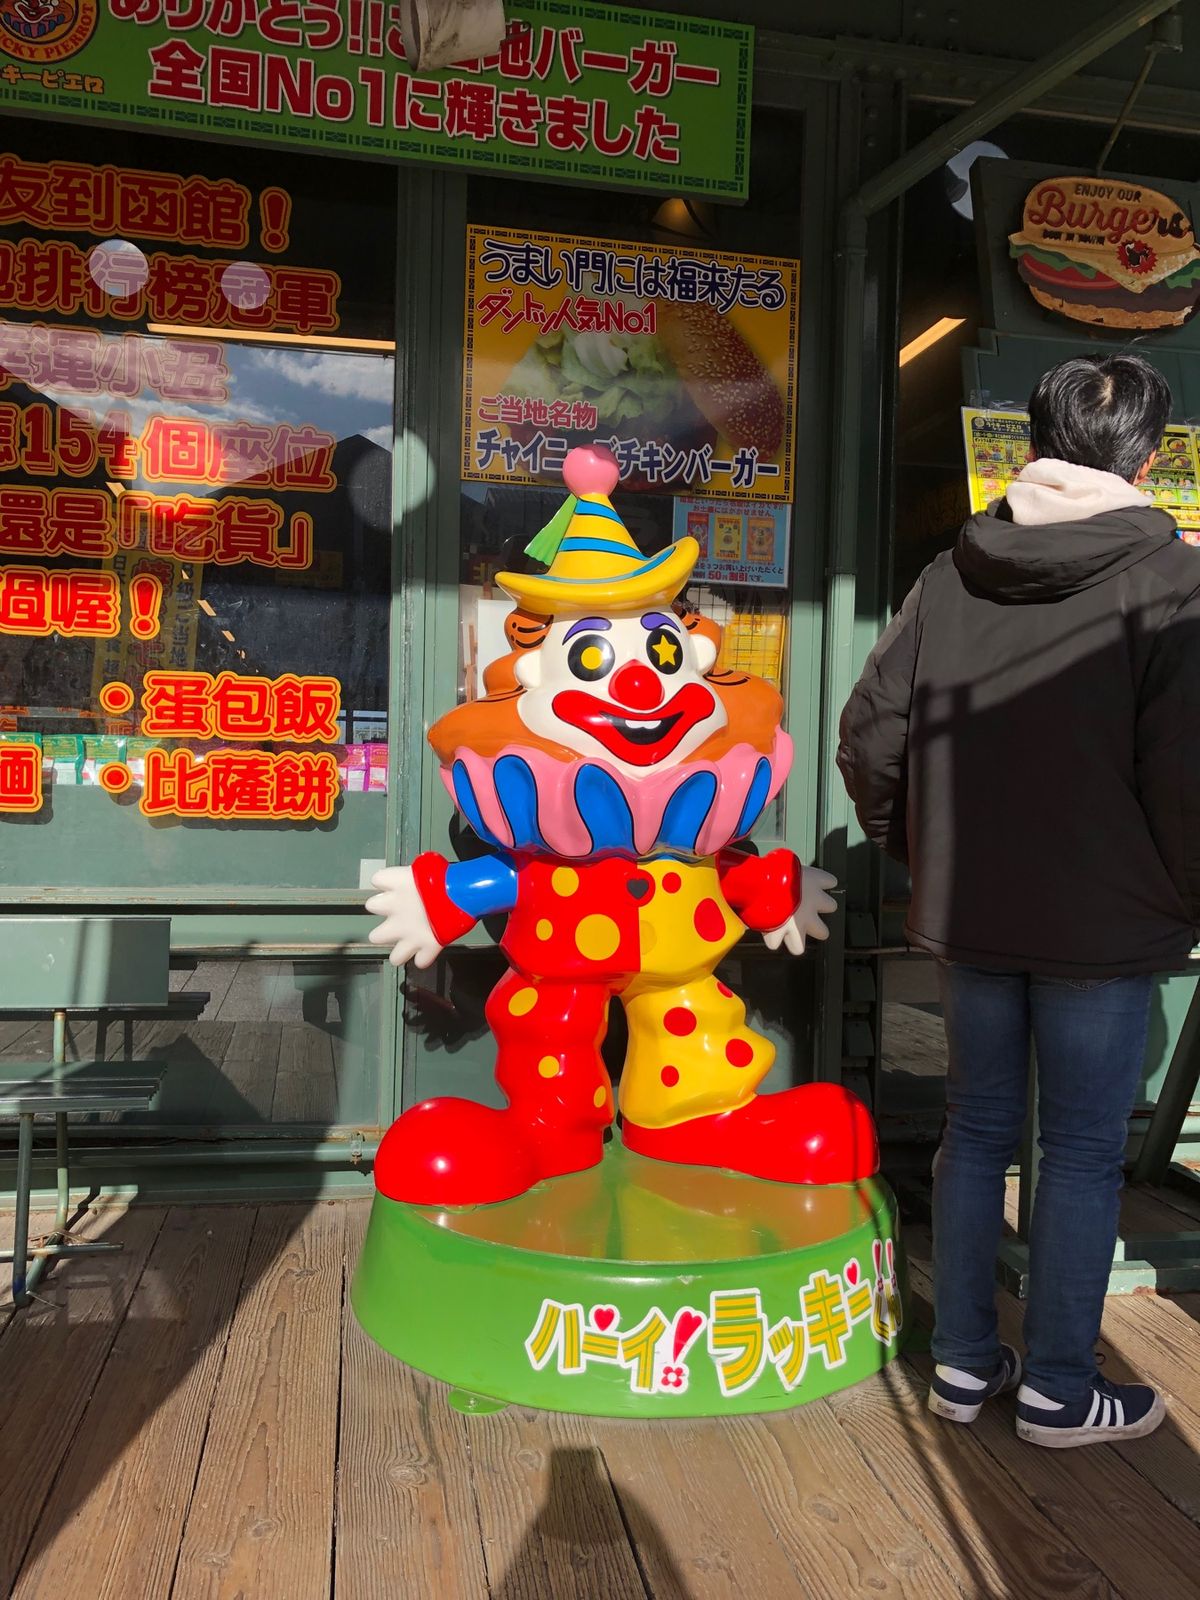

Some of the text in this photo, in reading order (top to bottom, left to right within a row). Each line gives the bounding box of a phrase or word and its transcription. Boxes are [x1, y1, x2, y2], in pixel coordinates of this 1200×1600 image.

[44, 3, 94, 58] PIERROT
[148, 38, 680, 163] 全国No1に輝きました
[1074, 183, 1142, 203] ENJOY OUR
[0, 238, 341, 334] 排行榜冠軍
[479, 239, 787, 314] うまい門には福来たる
[477, 394, 598, 430] ご当地名物
[475, 428, 780, 488] チャイニチキンバーガー
[141, 671, 341, 742] 蛋包飯
[139, 749, 340, 820] 比薩餅
